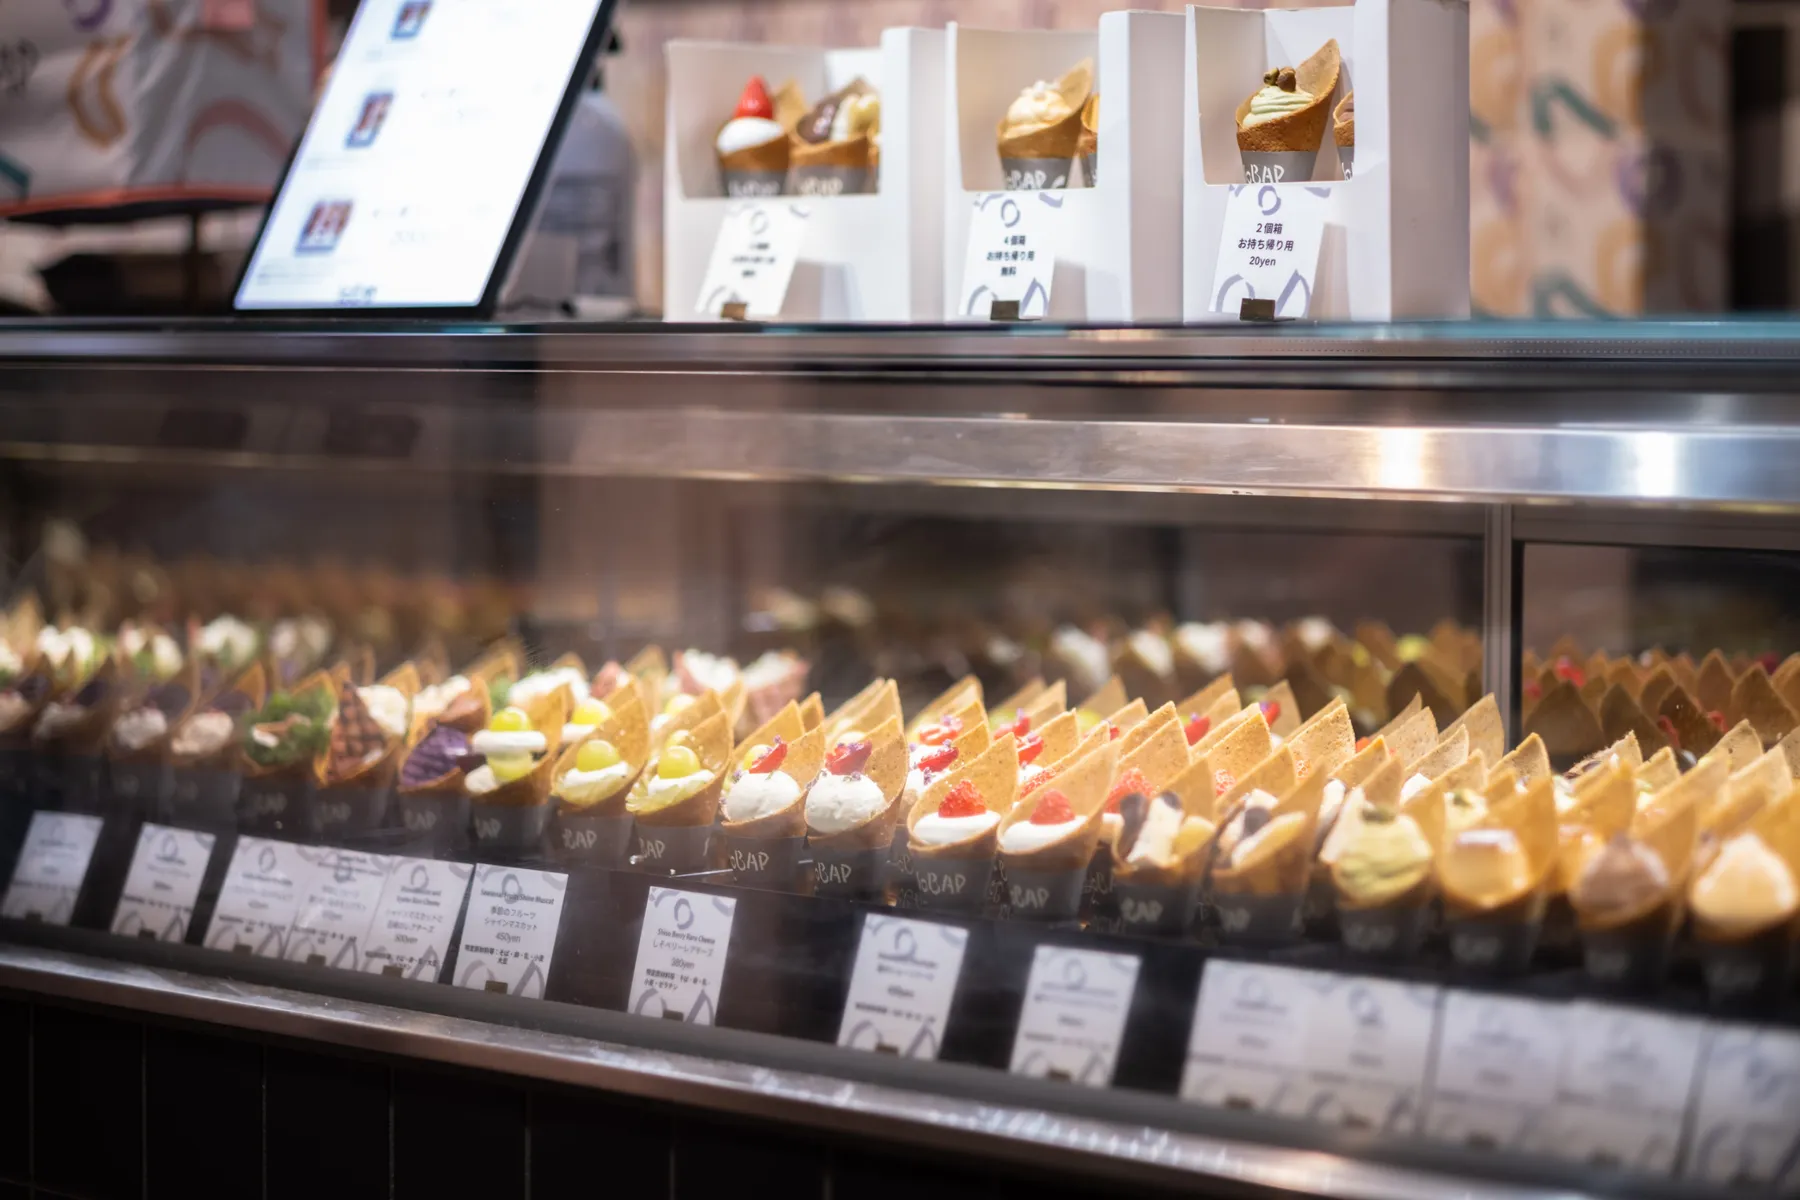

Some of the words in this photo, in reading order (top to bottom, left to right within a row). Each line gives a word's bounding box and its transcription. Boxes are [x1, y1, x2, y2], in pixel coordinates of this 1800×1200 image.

[1237, 238, 1294, 252] お持ち帰り用
[1249, 256, 1276, 267] 20yen
